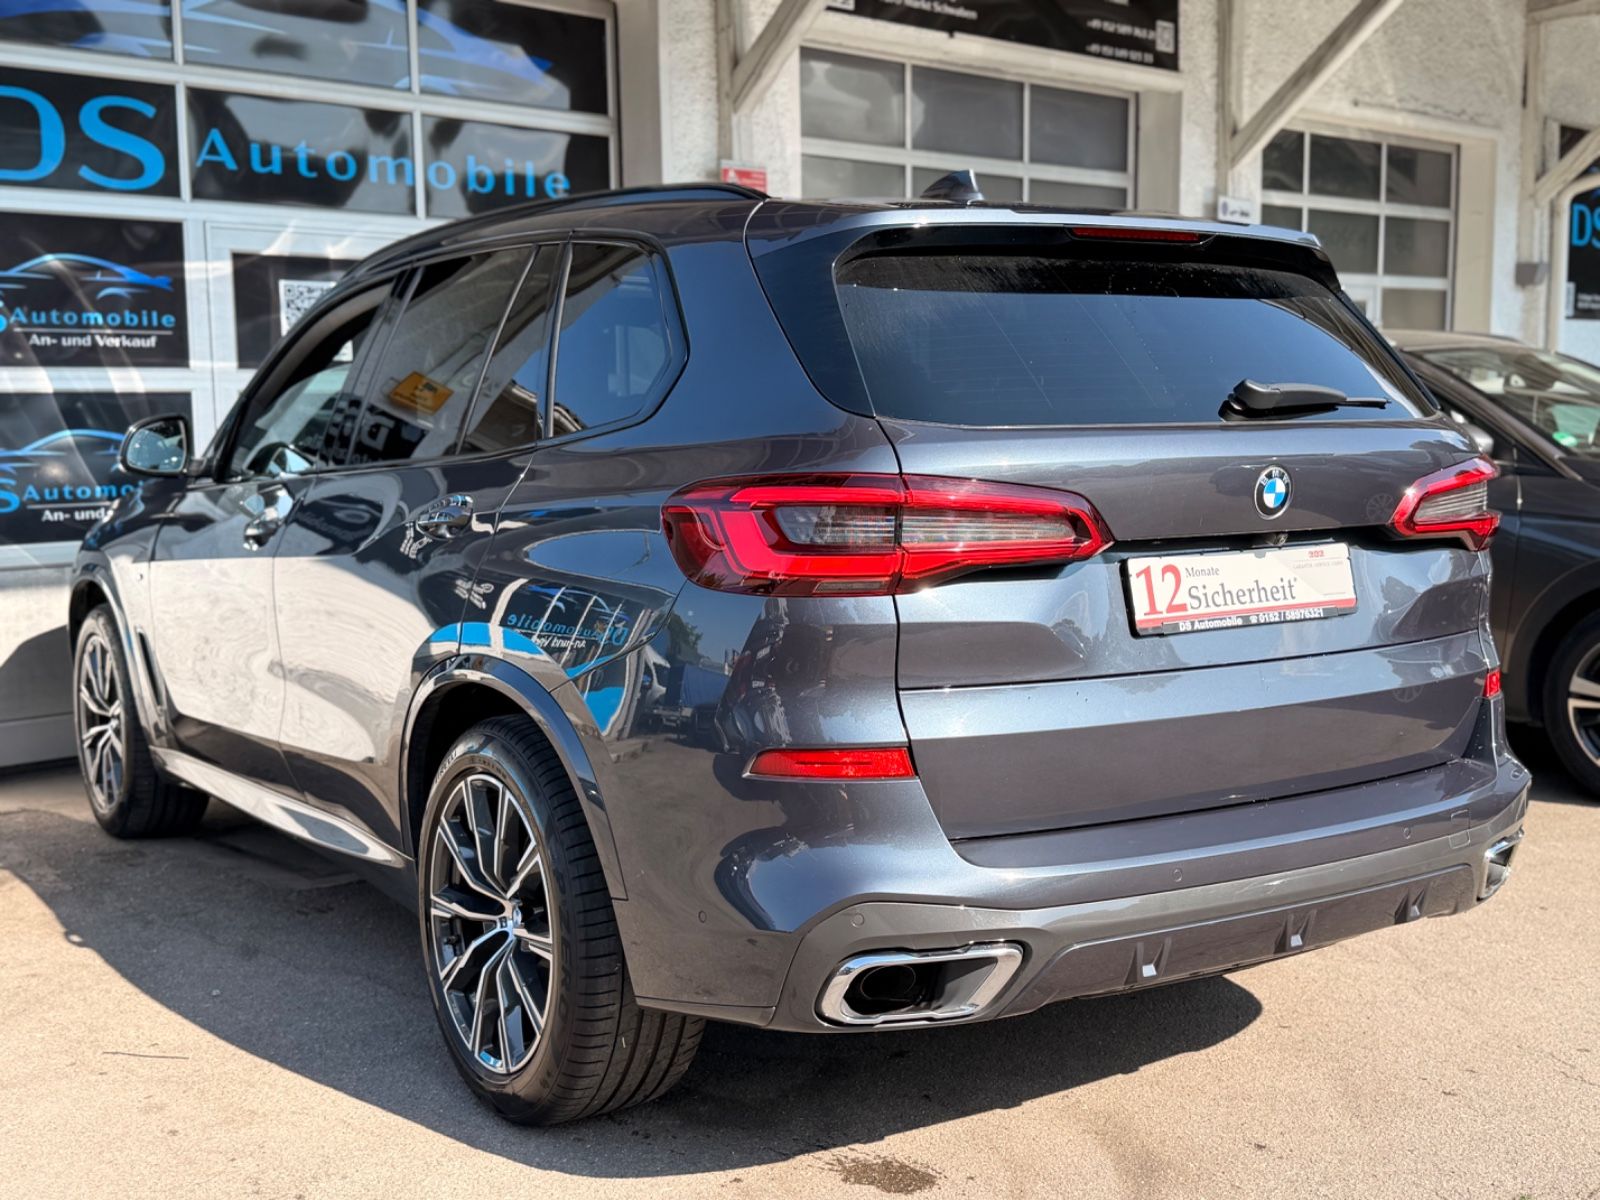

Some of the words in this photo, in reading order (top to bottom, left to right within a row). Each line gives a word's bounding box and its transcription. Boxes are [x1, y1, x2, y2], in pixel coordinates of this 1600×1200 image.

[195, 127, 571, 200] Automobile
[10, 306, 176, 328] Automobile
[29, 333, 58, 347] An-
[61, 334, 92, 347] und
[95, 335, 157, 348] Verkauf
[1259, 469, 1290, 486] BMW
[42, 509, 71, 522] An-
[74, 507, 106, 521] und
[1185, 566, 1220, 578] Monate
[1136, 564, 1188, 617] 12
[1179, 621, 1192, 632] DS
[1194, 616, 1243, 630] Automobile
